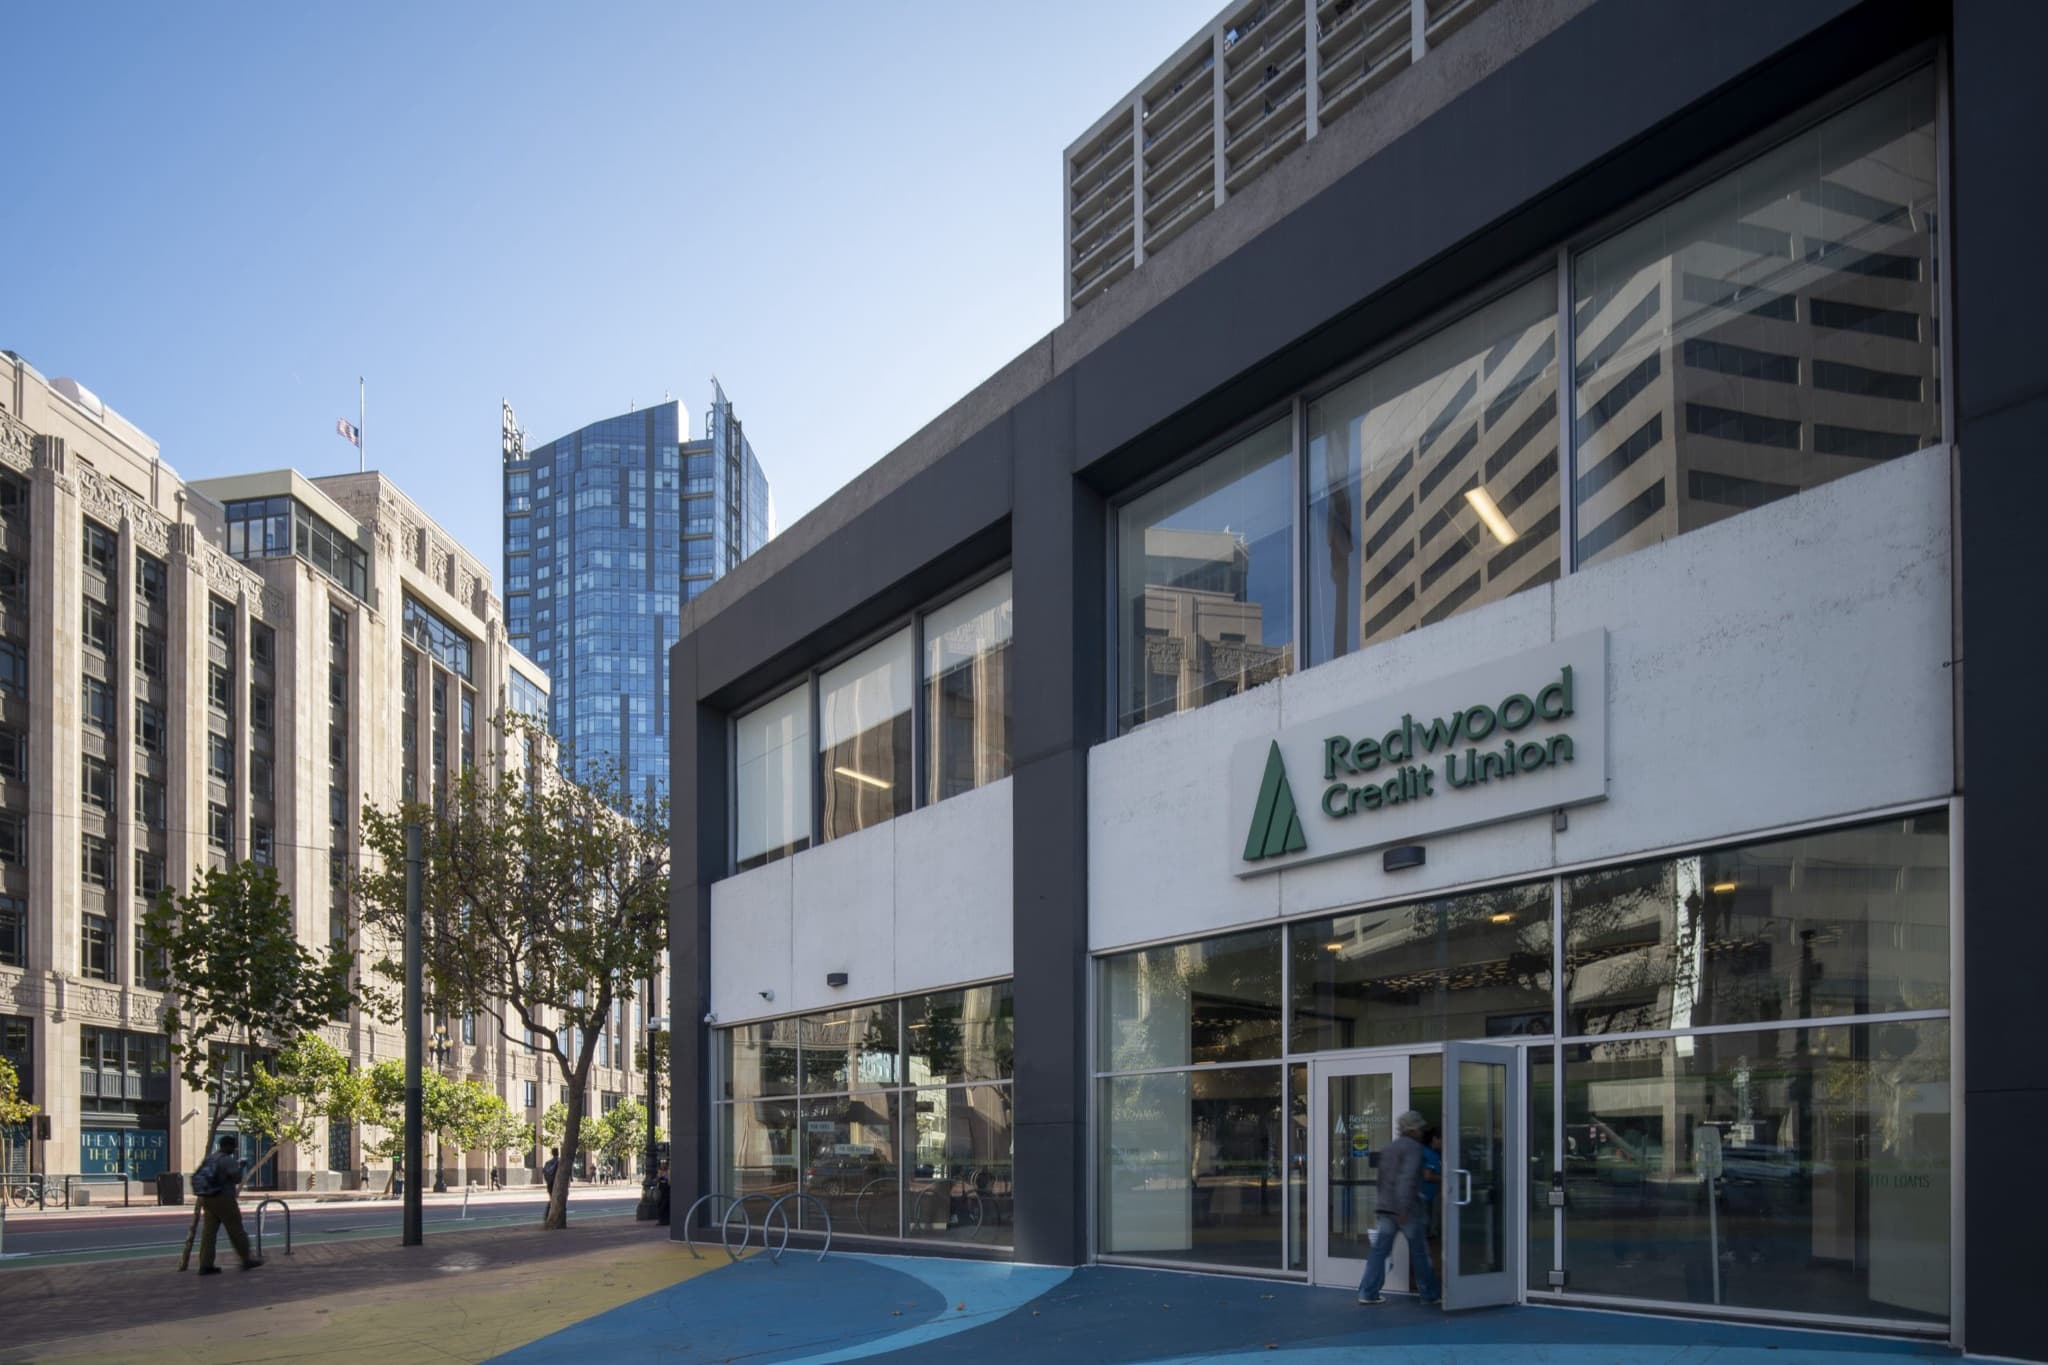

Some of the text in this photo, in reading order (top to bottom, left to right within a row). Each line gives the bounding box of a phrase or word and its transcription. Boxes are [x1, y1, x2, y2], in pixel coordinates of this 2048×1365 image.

[1324, 664, 1575, 780] Redwood
[1321, 733, 1574, 818] Credit Union
[81, 1134, 104, 1147] THE
[89, 1148, 111, 1160] THE
[1894, 1175, 1930, 1188] LOANS
